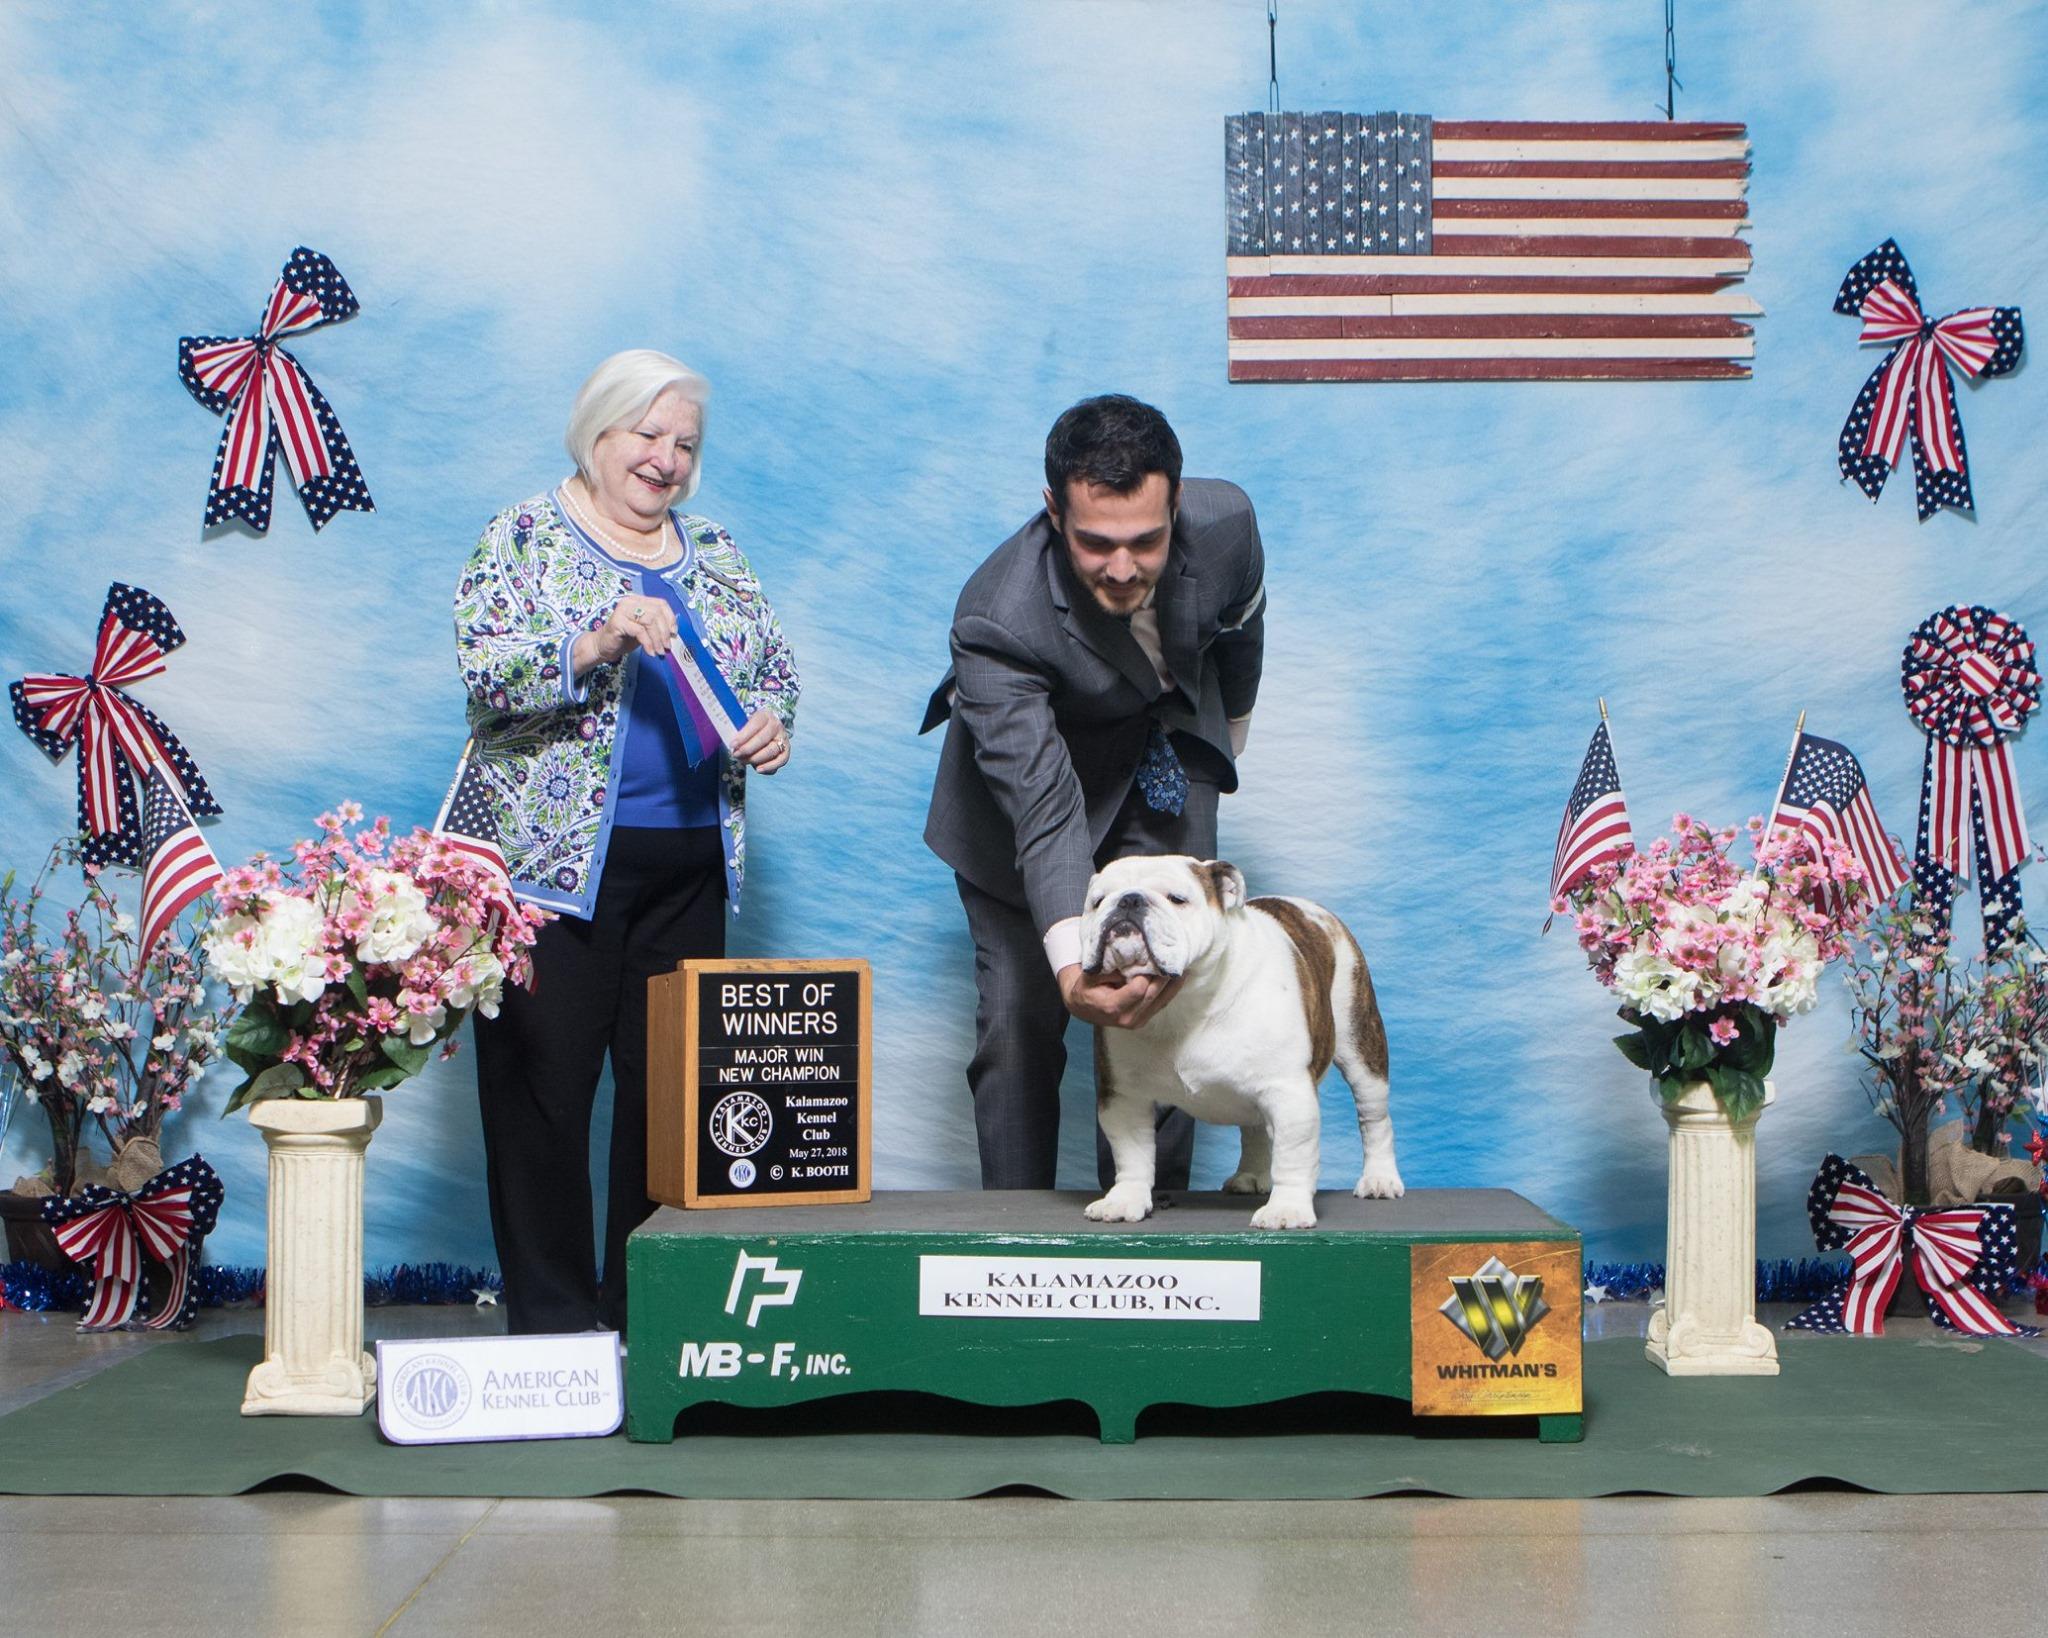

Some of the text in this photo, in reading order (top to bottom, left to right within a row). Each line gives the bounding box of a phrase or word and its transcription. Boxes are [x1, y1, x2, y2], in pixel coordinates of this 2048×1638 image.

[722, 984, 835, 1007] BEST OF
[722, 1012, 838, 1035] WINNERS
[735, 1048, 824, 1063] MAJOR WIN
[719, 1066, 840, 1082] NEW CHAMPION
[715, 1096, 767, 1120] KALAMAZOO
[785, 1096, 848, 1107] Kalamazoo
[797, 1112, 837, 1124] Kennel
[715, 1129, 768, 1153] KENNEL CLUB
[802, 1129, 830, 1140] Club
[789, 1147, 848, 1159] May 27, 2018
[791, 1167, 804, 1177] K.
[806, 1165, 849, 1177] BOOTH
[986, 1272, 1179, 1290] KALAMAZOO
[943, 1292, 1221, 1312] KENNEL CLUB, INC.
[806, 1354, 851, 1376] INC.
[1436, 1363, 1558, 1379] WHITMAN'S
[483, 1369, 599, 1391] AMERICAN
[406, 1368, 458, 1416] AKC
[483, 1393, 550, 1410] KENNEL
